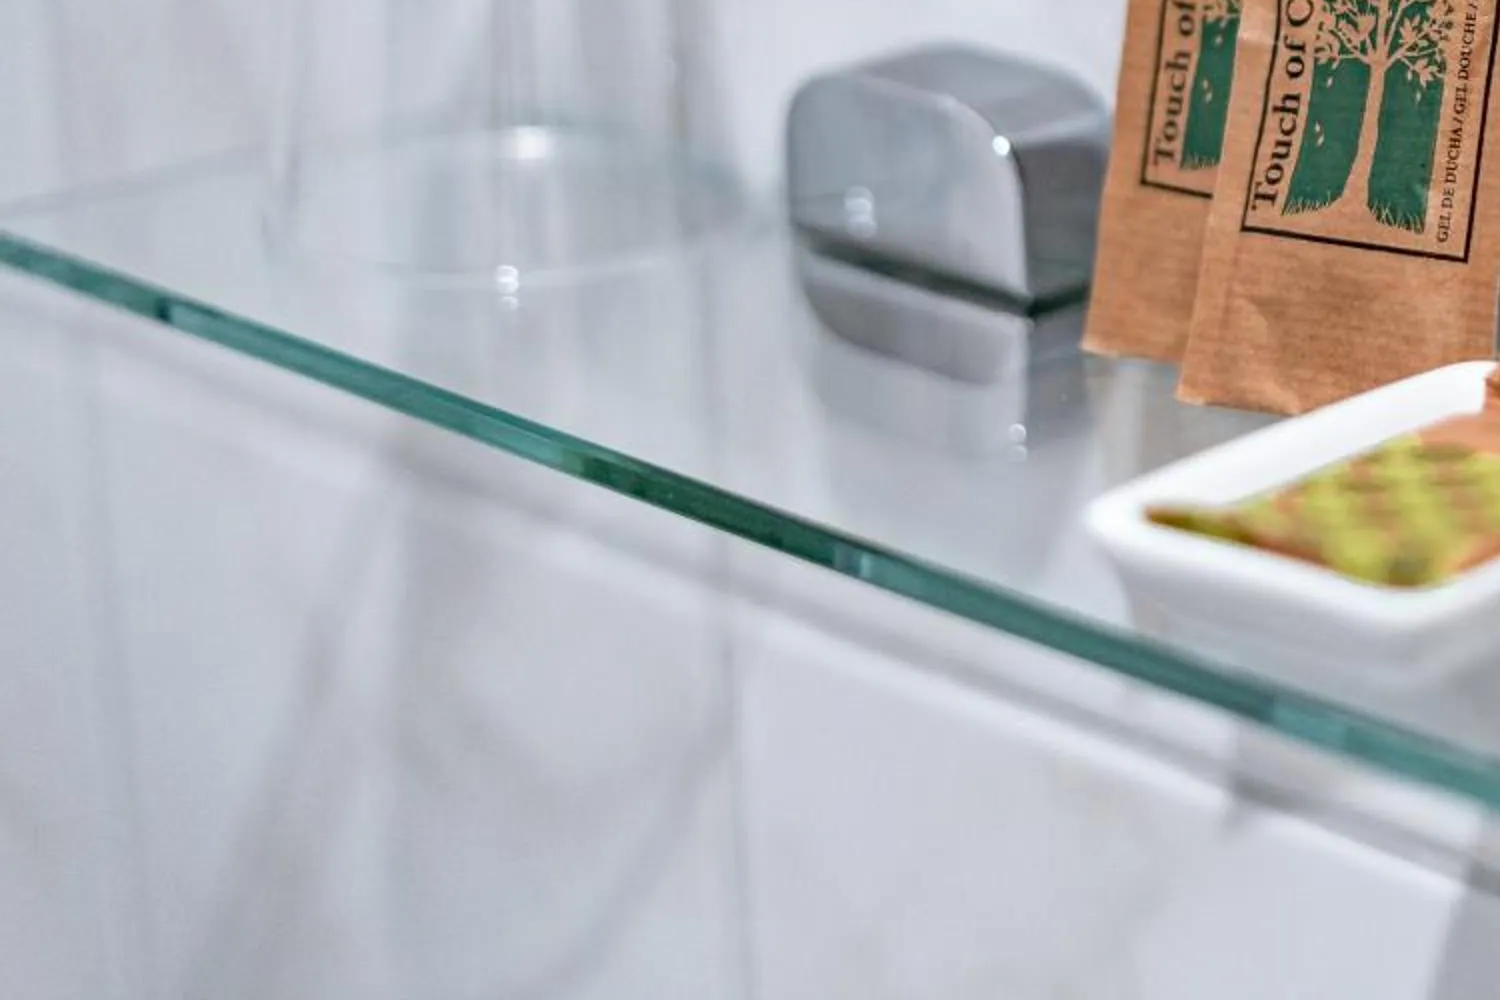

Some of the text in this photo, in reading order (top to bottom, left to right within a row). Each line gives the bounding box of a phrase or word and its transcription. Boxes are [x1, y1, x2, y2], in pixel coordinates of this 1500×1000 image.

[1457, 11, 1477, 80] DOUCHE
[1154, 52, 1192, 165] Touch
[1251, 92, 1302, 210] Touch
[1284, 34, 1306, 79] of
[1453, 83, 1468, 115] GEL
[1445, 127, 1463, 183] DUCHA
[1441, 187, 1455, 208] DE
[1436, 211, 1452, 243] GEL
